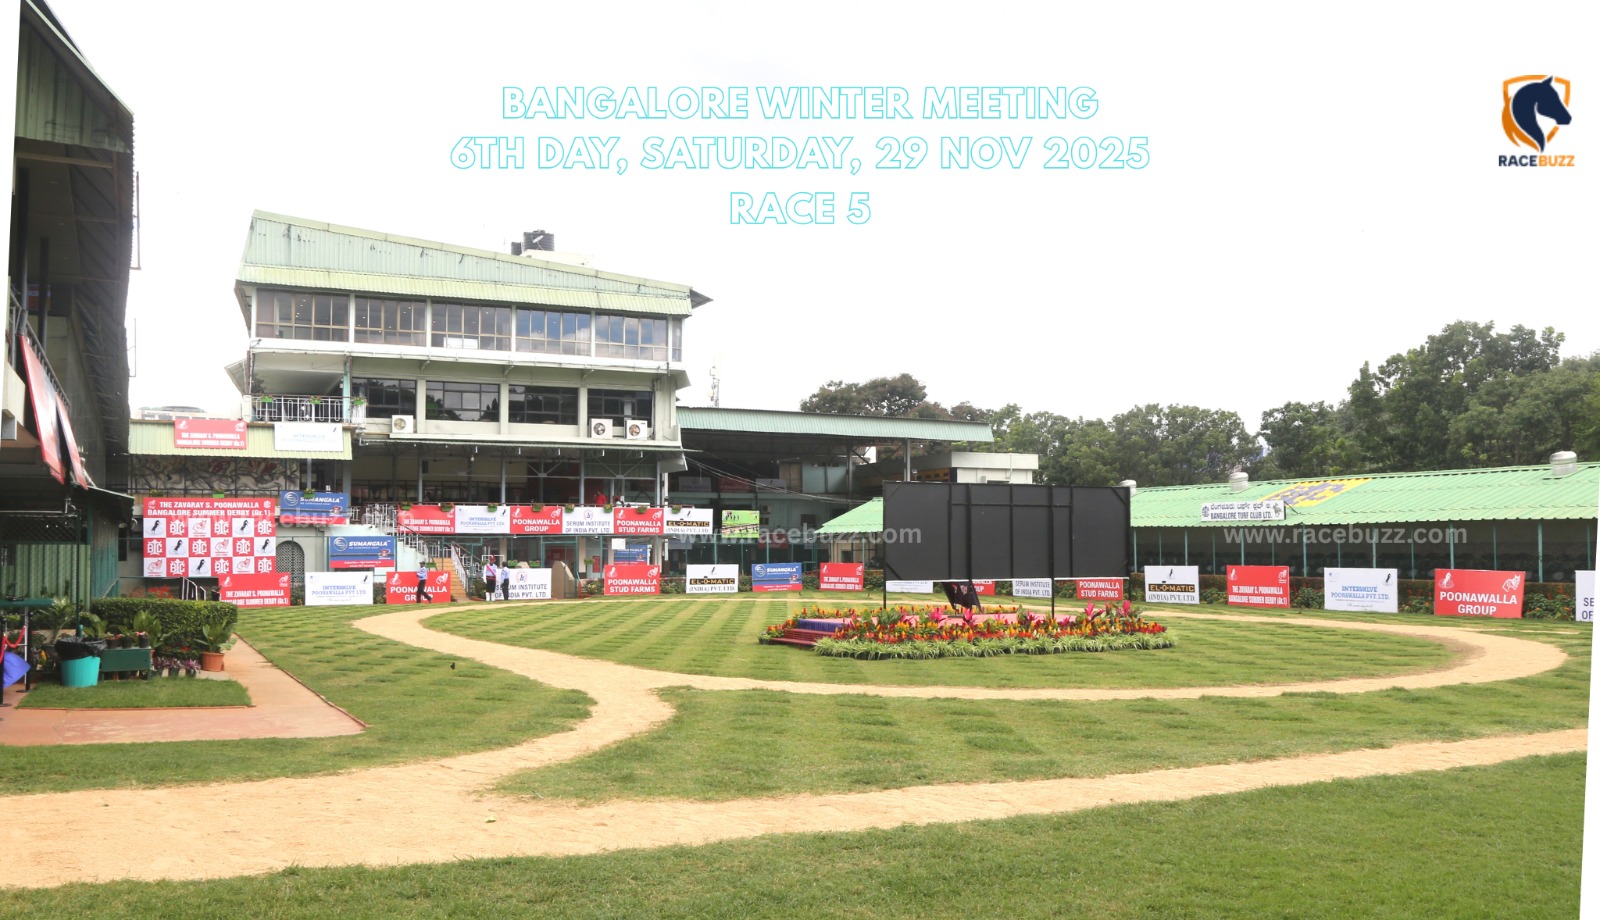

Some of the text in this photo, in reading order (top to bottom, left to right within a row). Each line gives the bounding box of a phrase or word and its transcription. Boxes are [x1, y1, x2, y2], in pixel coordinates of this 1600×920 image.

[1150, 584, 1195, 592] EL-O-MATIC
[1081, 590, 1118, 598] STUD FARMS
[1440, 592, 1517, 604] POONAWALLA
[1458, 605, 1496, 615] GROUP
[1582, 610, 1594, 619] OF
